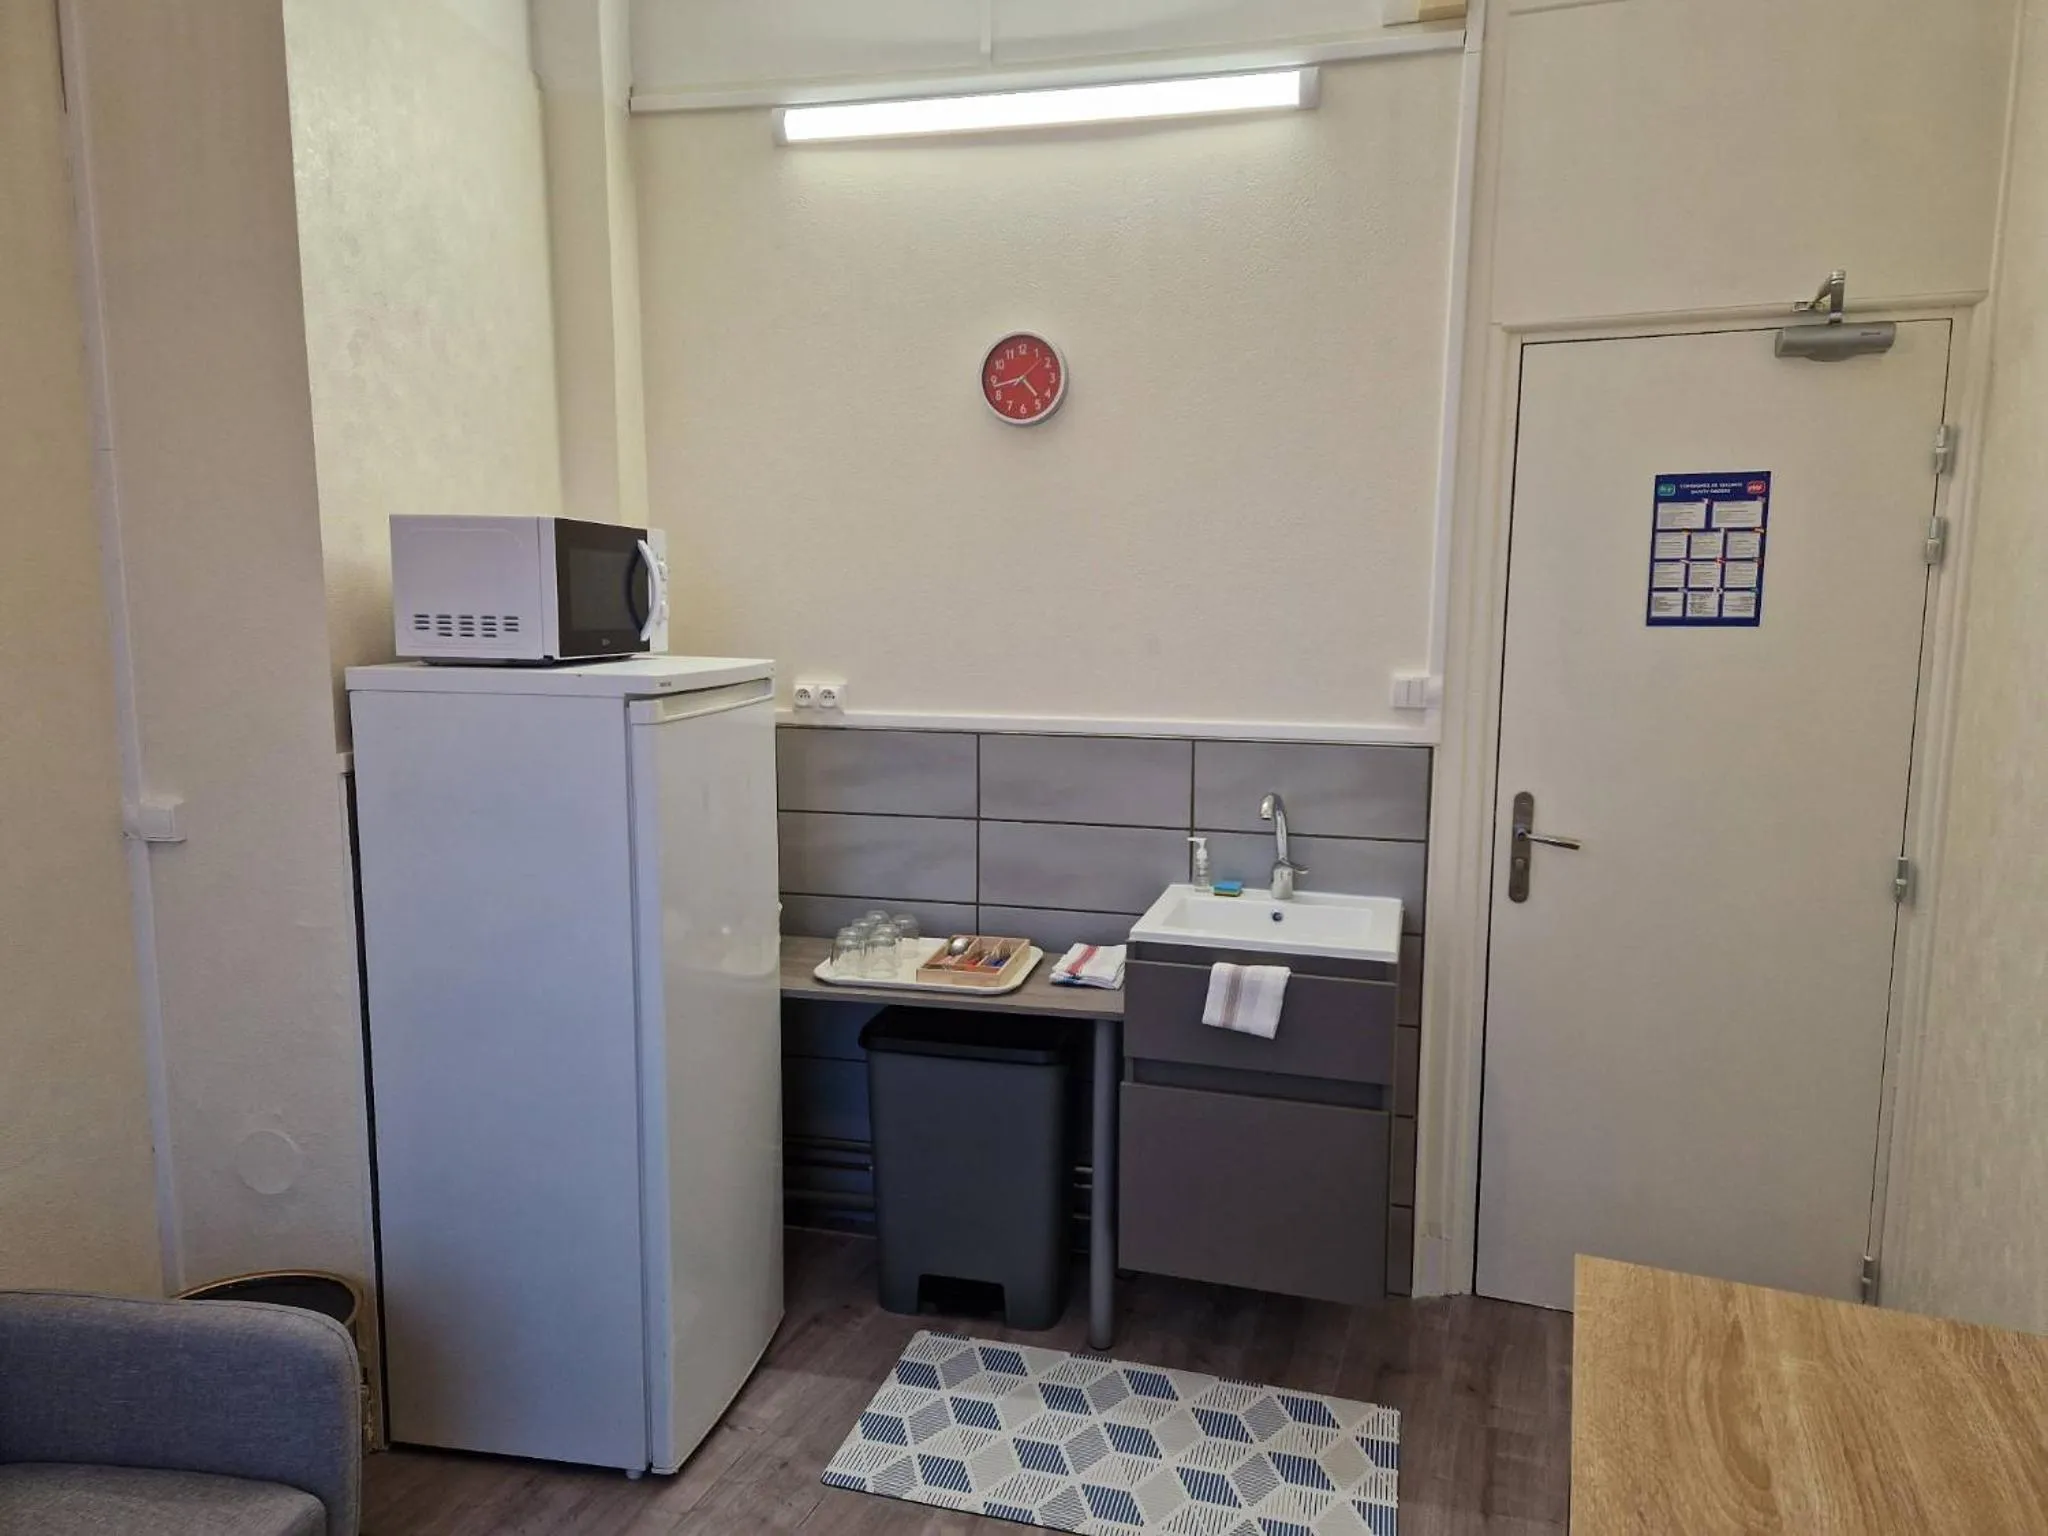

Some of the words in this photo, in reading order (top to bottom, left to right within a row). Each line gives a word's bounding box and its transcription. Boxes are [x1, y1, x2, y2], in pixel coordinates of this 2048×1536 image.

[1005, 348, 1014, 360] 11
[1018, 343, 1027, 355] 12
[1034, 347, 1039, 358] 1
[995, 359, 1005, 370] 10
[1044, 357, 1052, 368] 2
[990, 374, 998, 385] 9
[1049, 372, 1056, 384] 3
[995, 389, 1002, 400] 8
[1044, 388, 1051, 399] 4
[1006, 400, 1013, 411] 7
[1019, 403, 1027, 414] 6
[1034, 398, 1041, 410] 5
